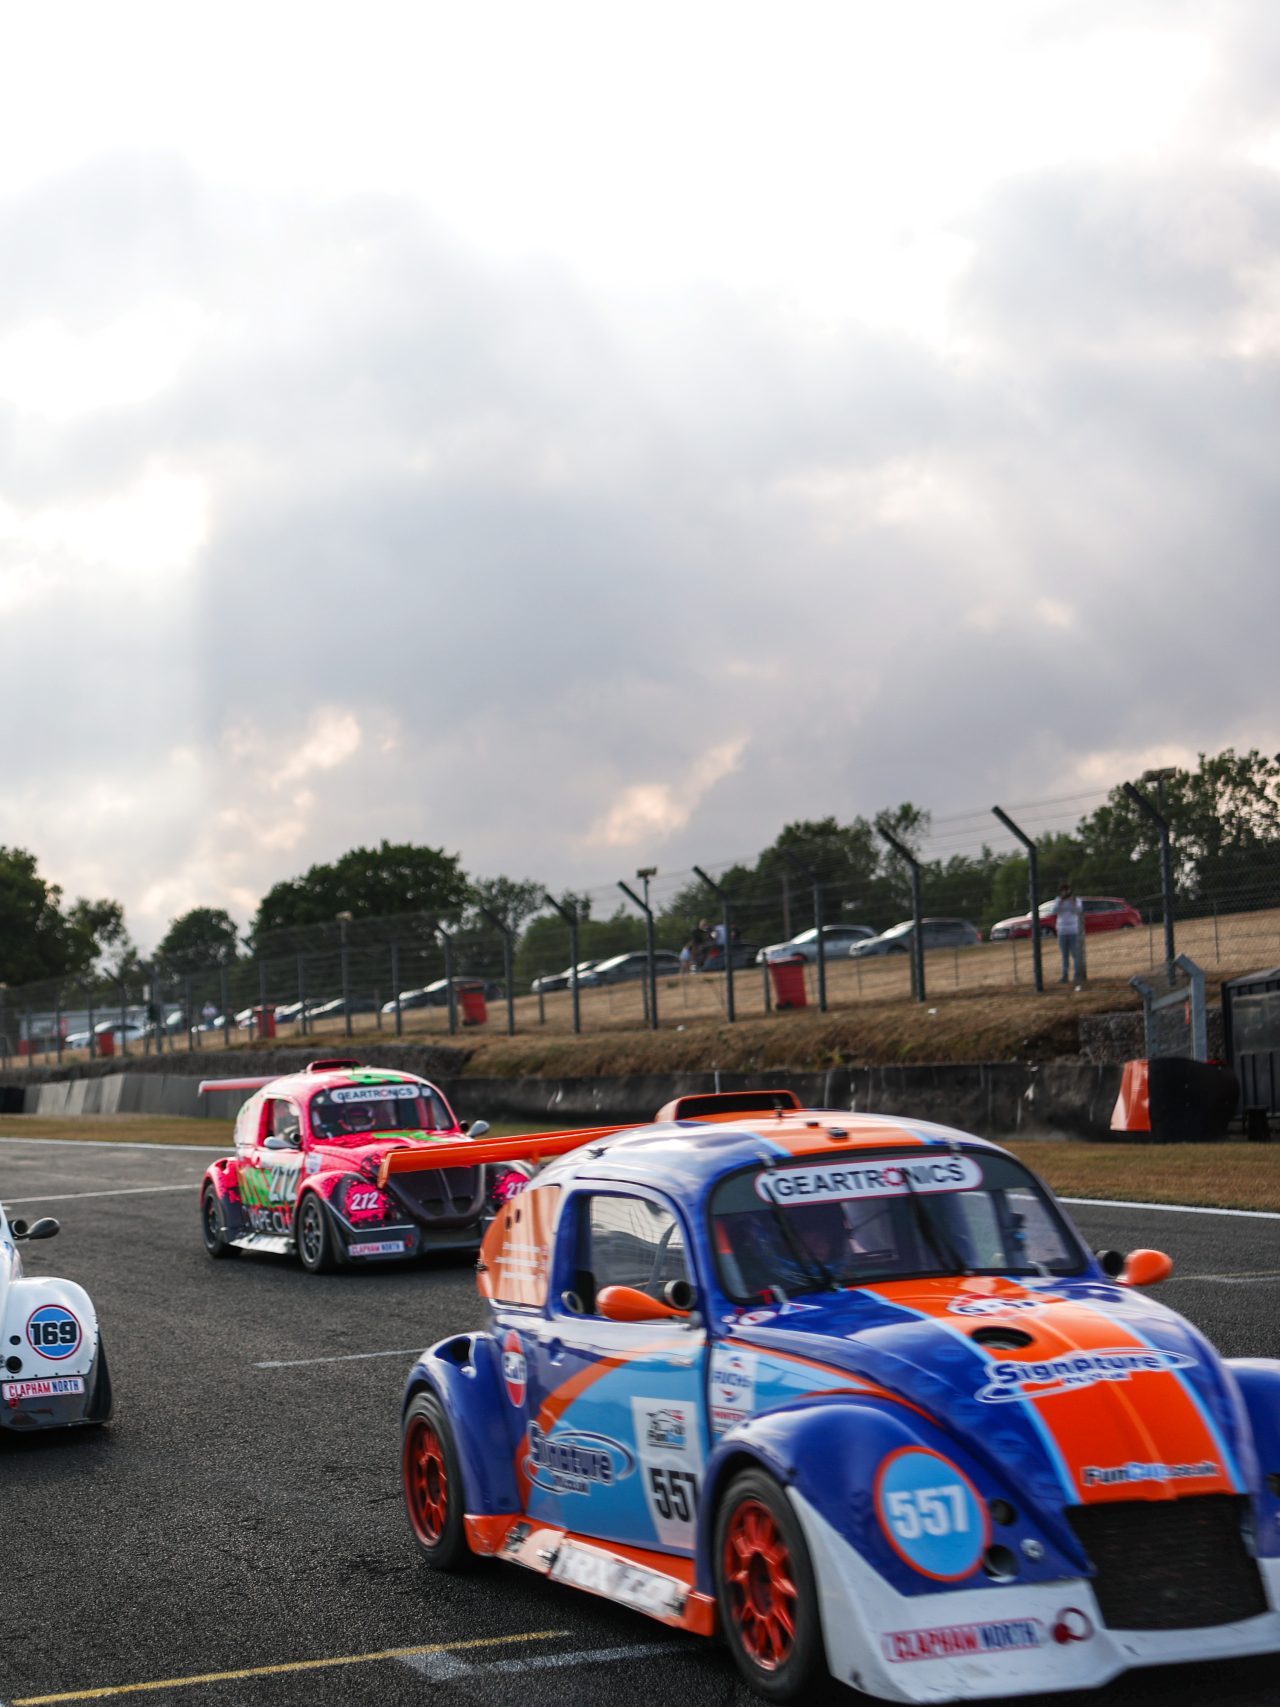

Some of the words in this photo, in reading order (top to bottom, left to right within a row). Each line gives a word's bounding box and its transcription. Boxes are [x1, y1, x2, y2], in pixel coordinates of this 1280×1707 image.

[337, 1087, 413, 1101] GEARTRONICS
[773, 1162, 966, 1197] GEARTRONICS
[350, 1191, 378, 1211] 212
[30, 1320, 77, 1346] 169
[9, 1382, 51, 1398] CLAPHAM
[51, 1380, 79, 1393] NORTH
[648, 1467, 699, 1523] 557
[886, 1484, 969, 1540] 557
[894, 1627, 979, 1659] CLAPHAM
[980, 1621, 1040, 1649] NORTH
